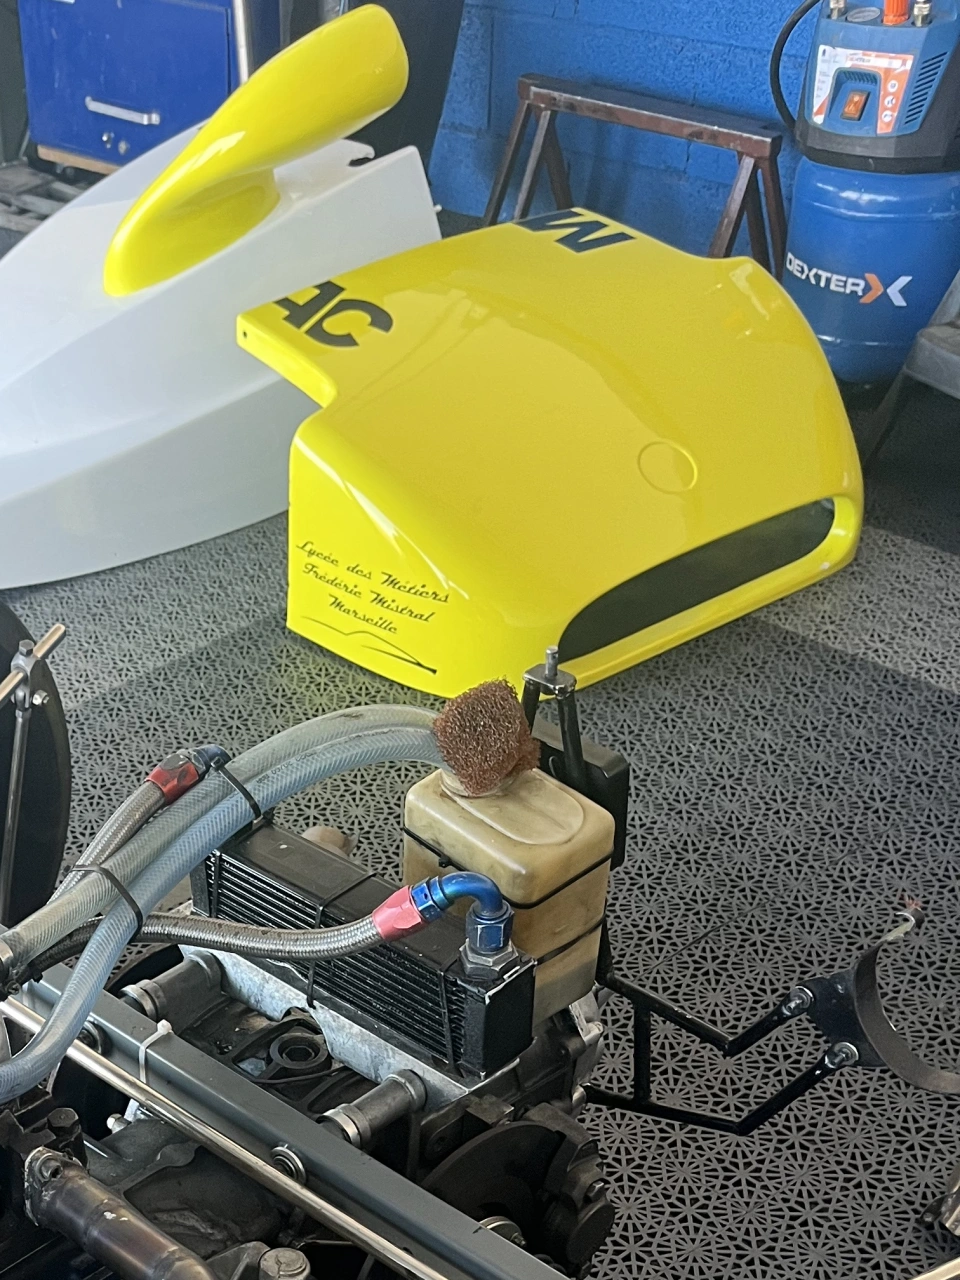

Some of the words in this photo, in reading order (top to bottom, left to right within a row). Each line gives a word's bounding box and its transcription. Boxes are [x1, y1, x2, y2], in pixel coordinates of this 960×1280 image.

[295, 540, 339, 567] Lycée
[346, 563, 372, 580] des
[380, 570, 450, 603] Métiers
[302, 562, 362, 599] Frédéric
[369, 589, 436, 623] Mistral
[327, 593, 398, 634] Marseille
